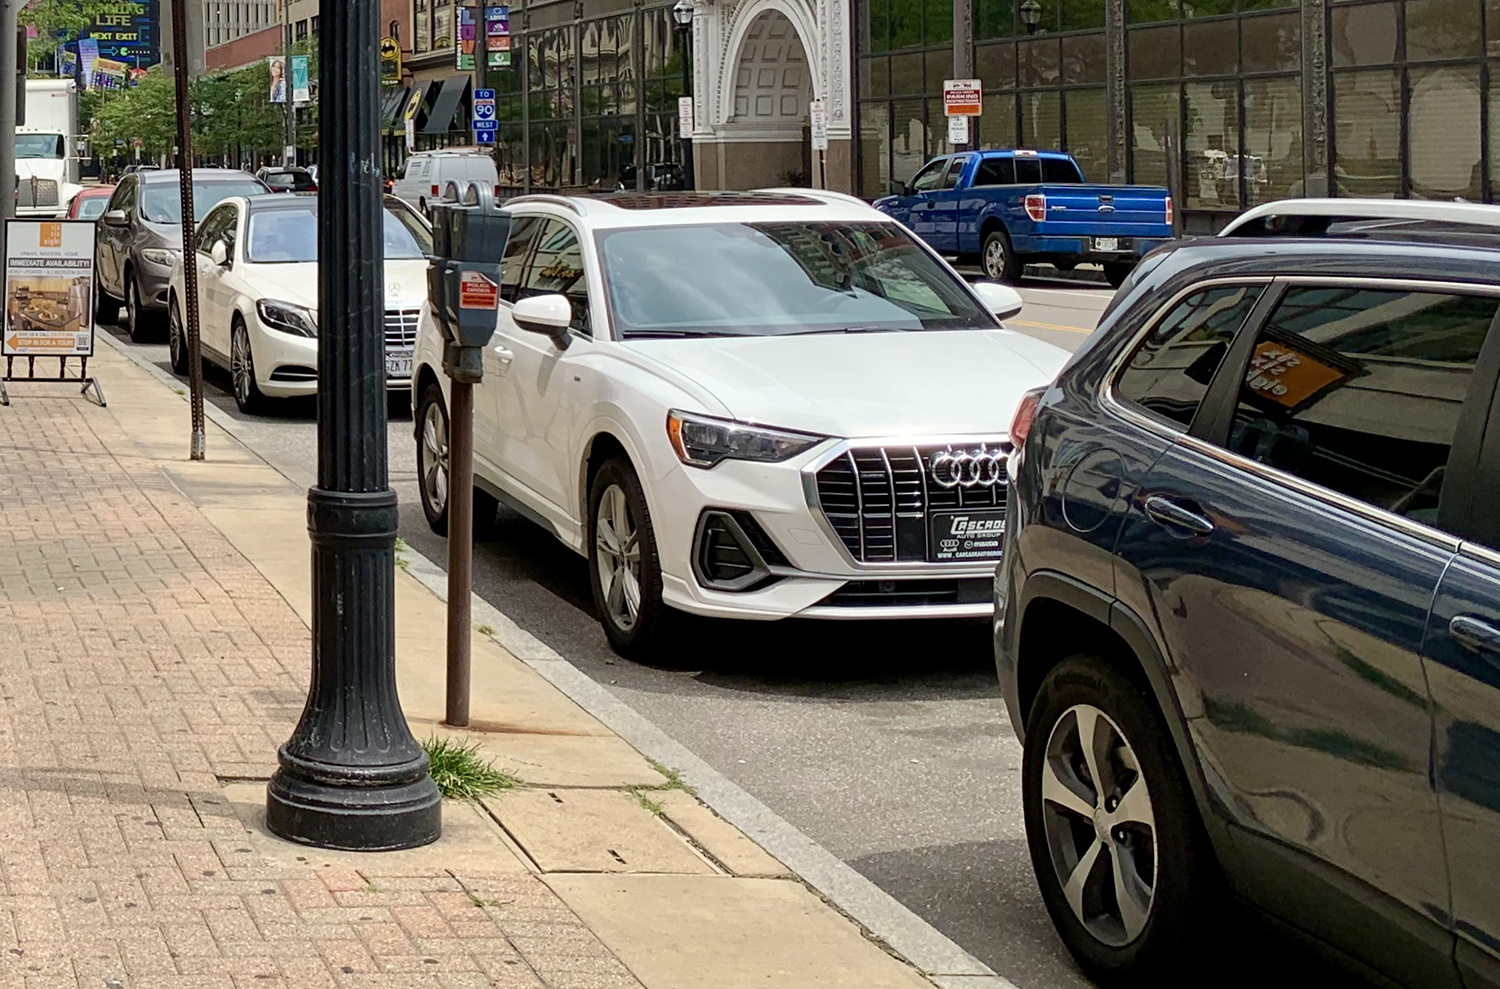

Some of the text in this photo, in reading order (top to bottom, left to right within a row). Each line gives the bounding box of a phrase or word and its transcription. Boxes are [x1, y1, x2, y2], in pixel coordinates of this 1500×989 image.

[96, 15, 131, 26] LIFE
[89, 32, 137, 41] NEXT EXIT
[462, 10, 476, 69] LOVE
[476, 105, 493, 115] 90
[10, 259, 90, 267] IMMEDIATE AVAILABILITY!
